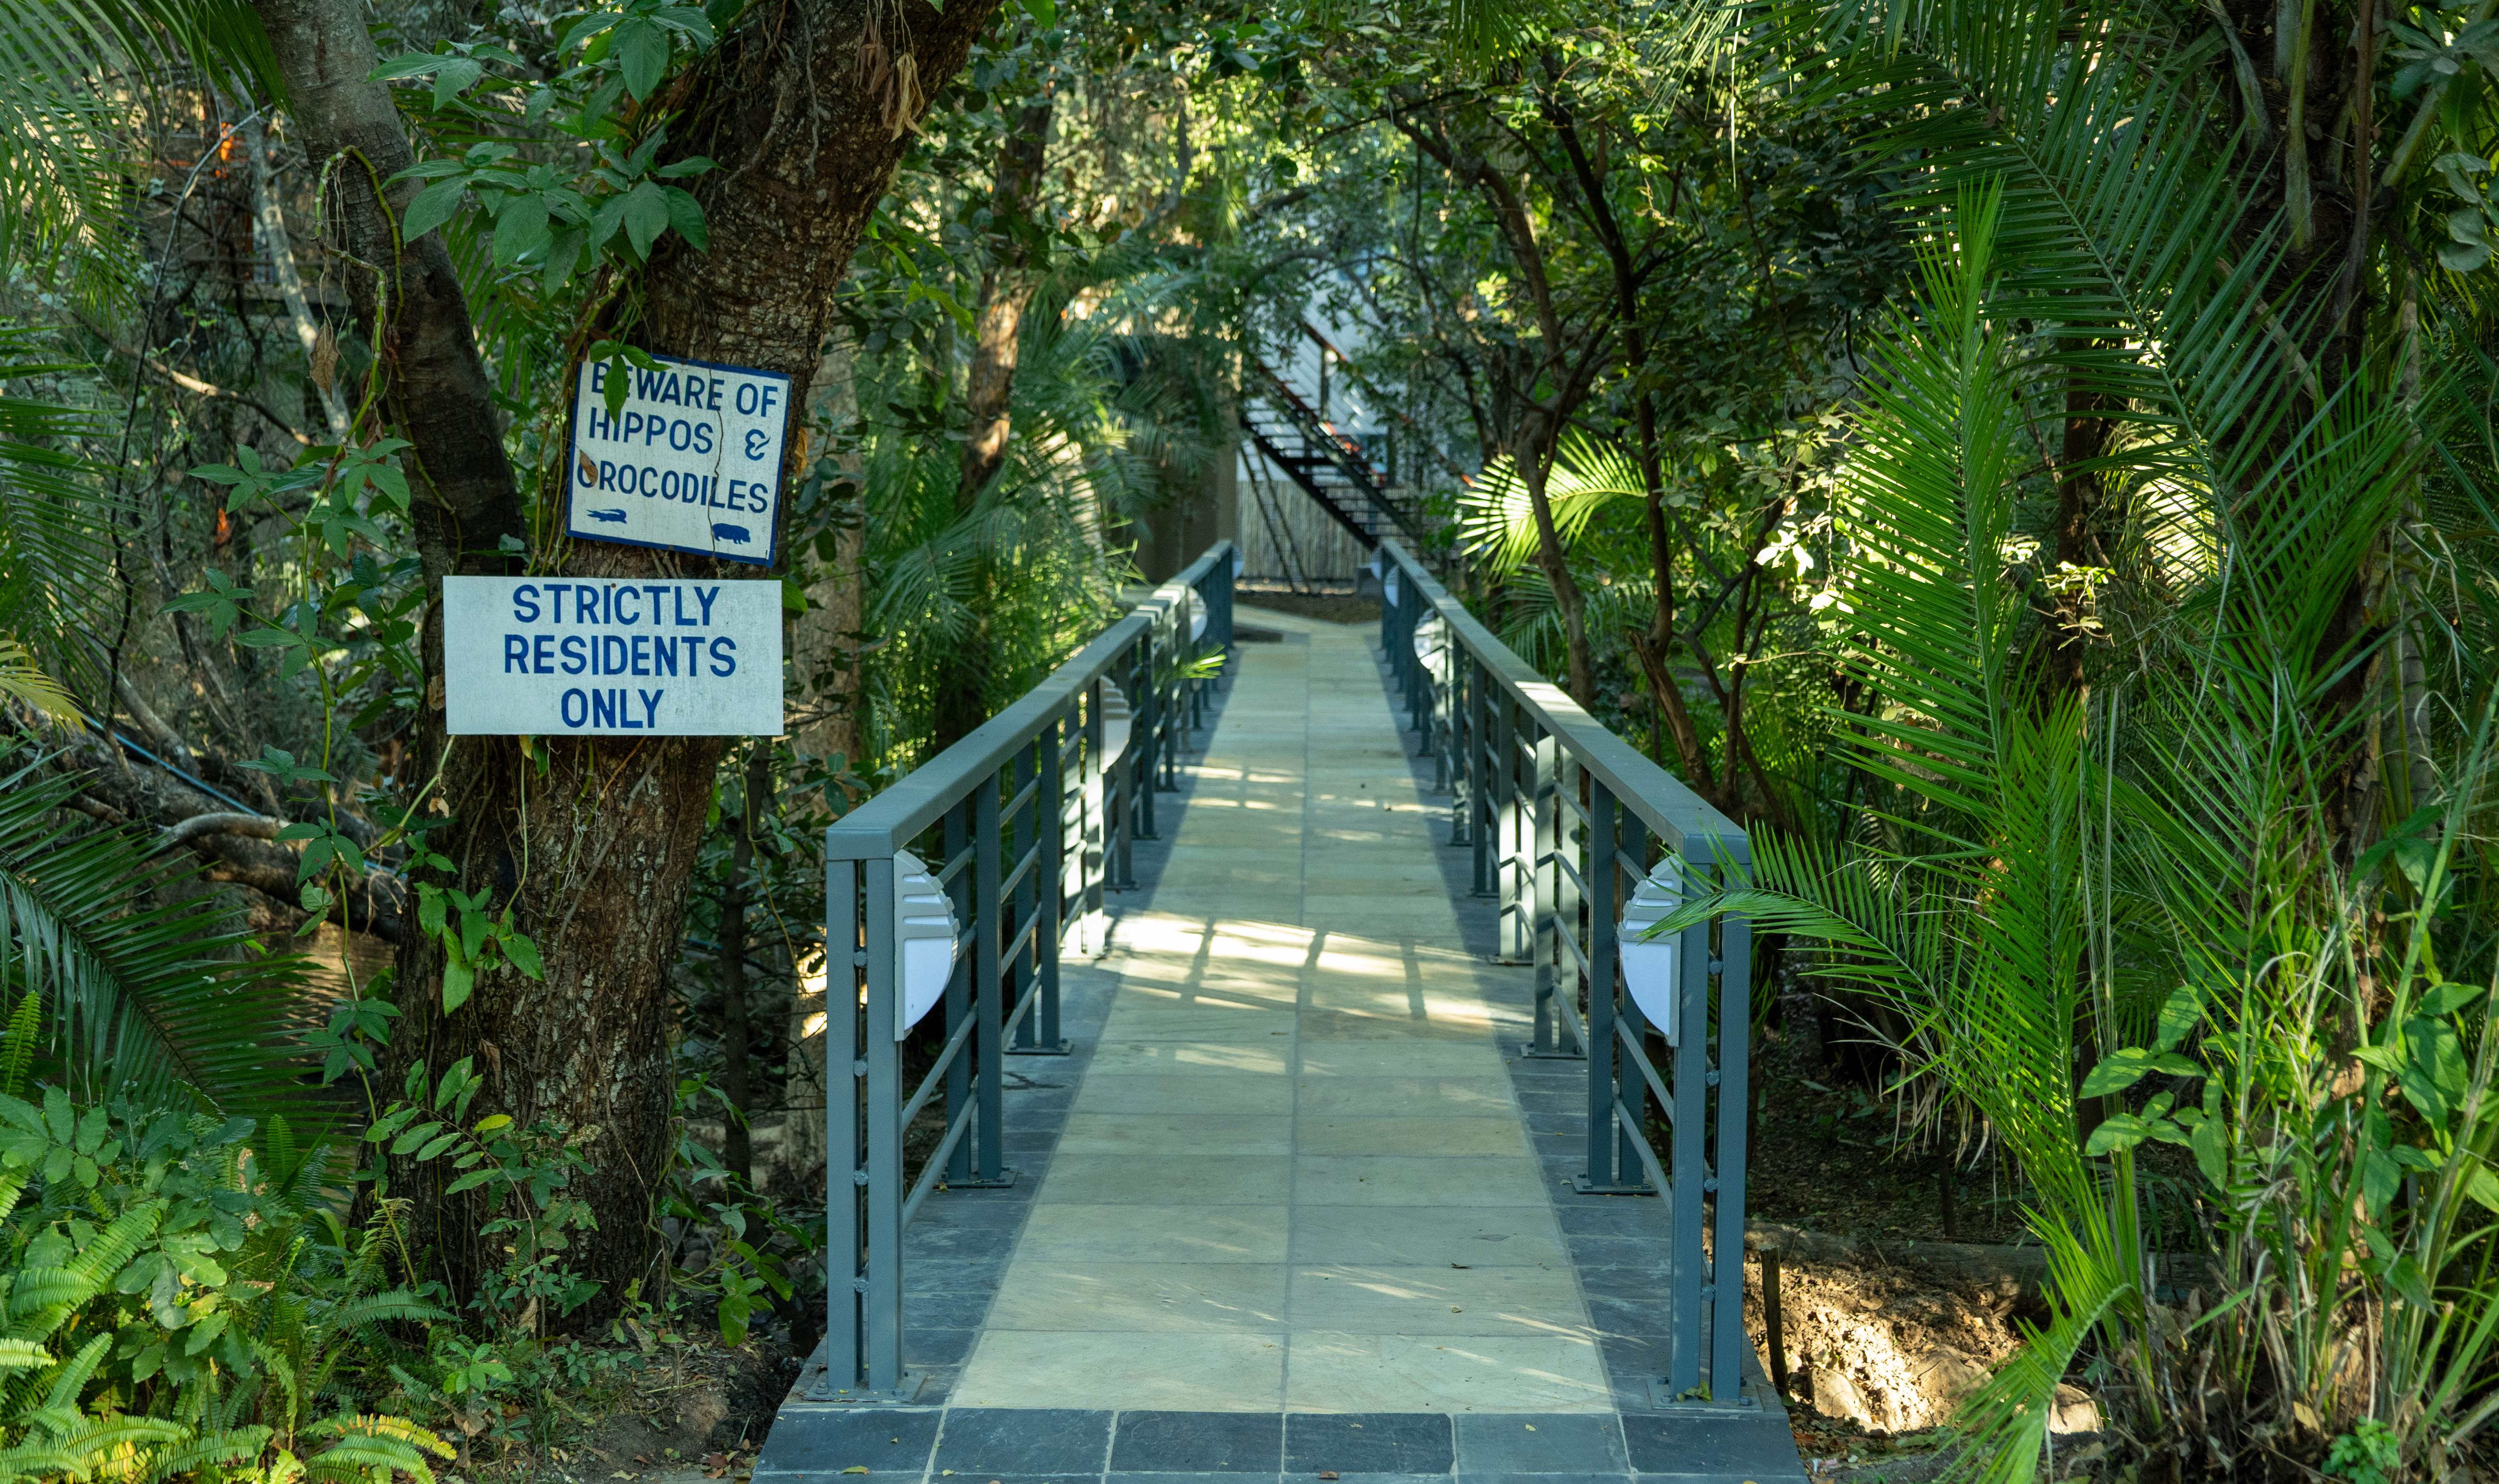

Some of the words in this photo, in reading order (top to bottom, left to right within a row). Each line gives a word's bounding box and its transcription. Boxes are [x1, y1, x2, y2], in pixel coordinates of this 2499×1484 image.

[591, 362, 725, 411] BWARE
[736, 383, 778, 417] OF
[589, 407, 713, 454] HIPPOS
[744, 428, 771, 461] &
[577, 459, 768, 514] CROCODILES
[513, 584, 720, 626] STRICTLY
[504, 634, 736, 677] RESIDENTS
[561, 688, 664, 728] ONLY
